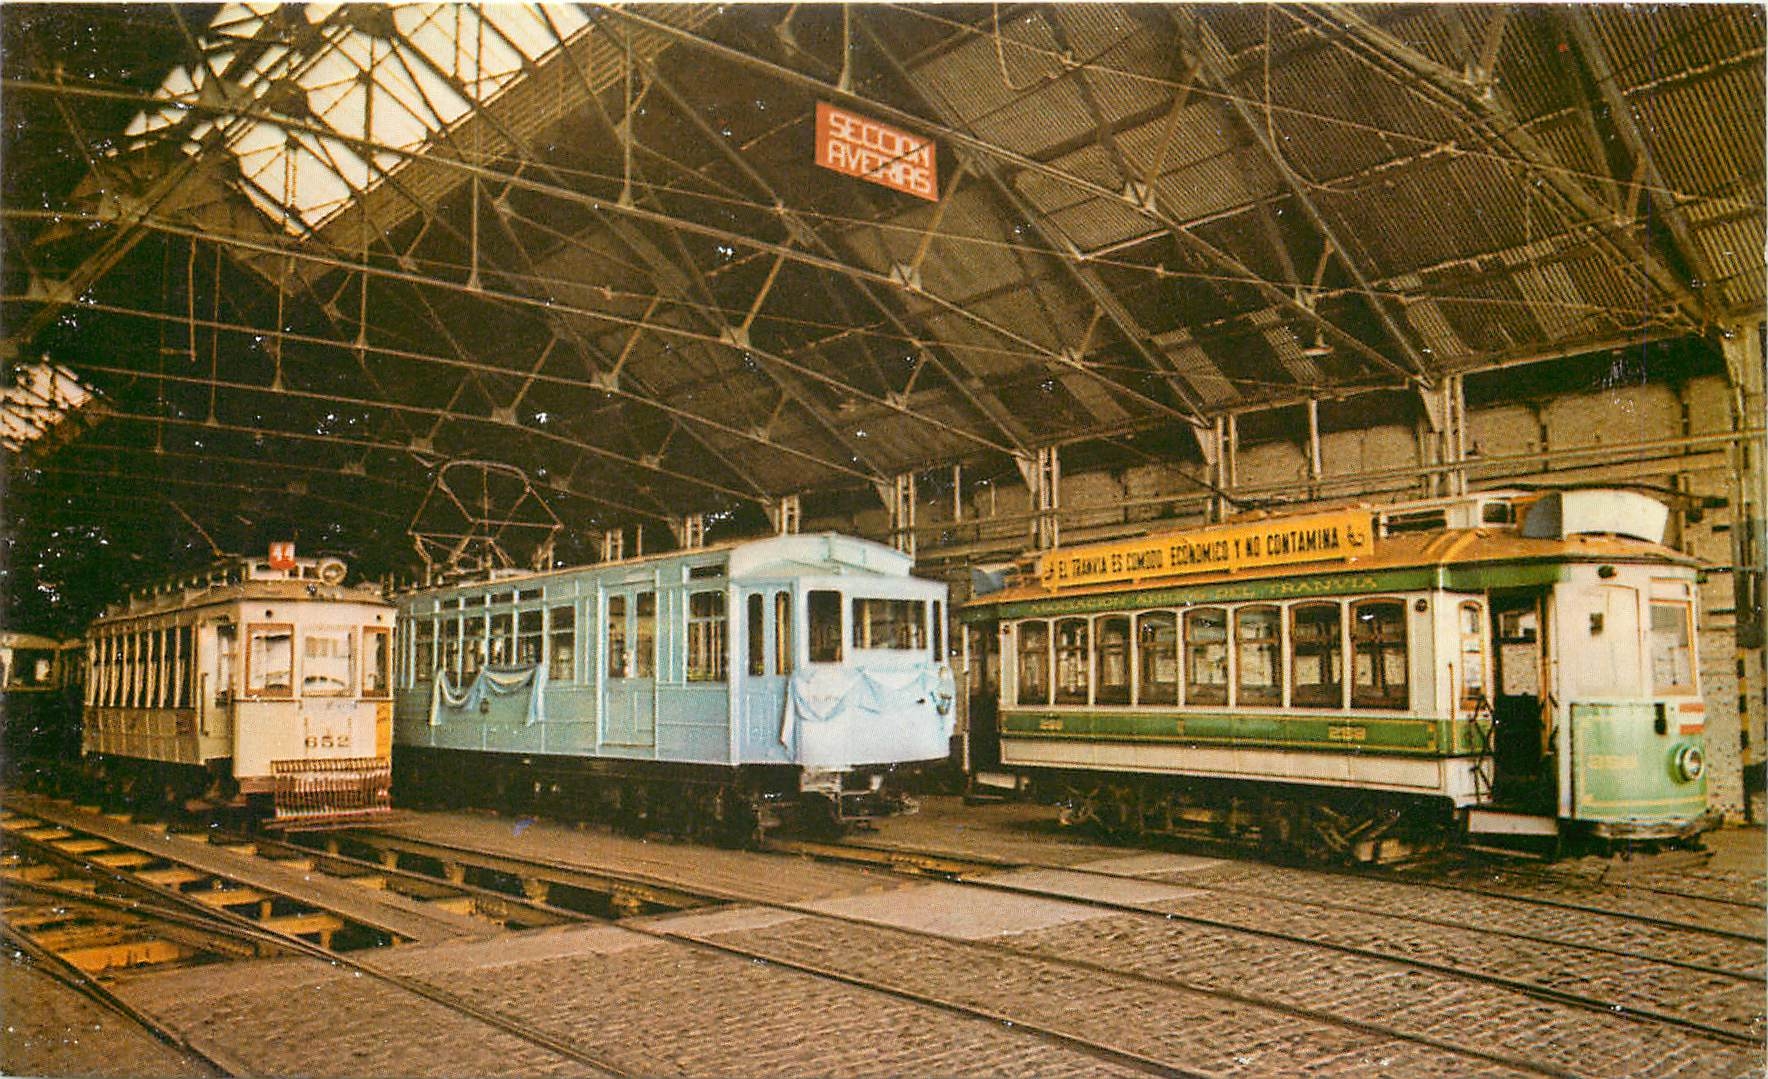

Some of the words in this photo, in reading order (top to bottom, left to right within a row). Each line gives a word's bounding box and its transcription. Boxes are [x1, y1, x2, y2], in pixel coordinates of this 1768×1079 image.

[827, 139, 931, 193] AVERIAS
[829, 111, 930, 168] SECCION
[1058, 560, 1068, 579] EL
[1111, 553, 1123, 573] ES
[1234, 537, 1241, 559] Y
[1245, 535, 1261, 558] NO
[1266, 526, 1340, 556] CONTAMINA
[1270, 576, 1378, 594] TRANVIA
[304, 735, 350, 748] 652
